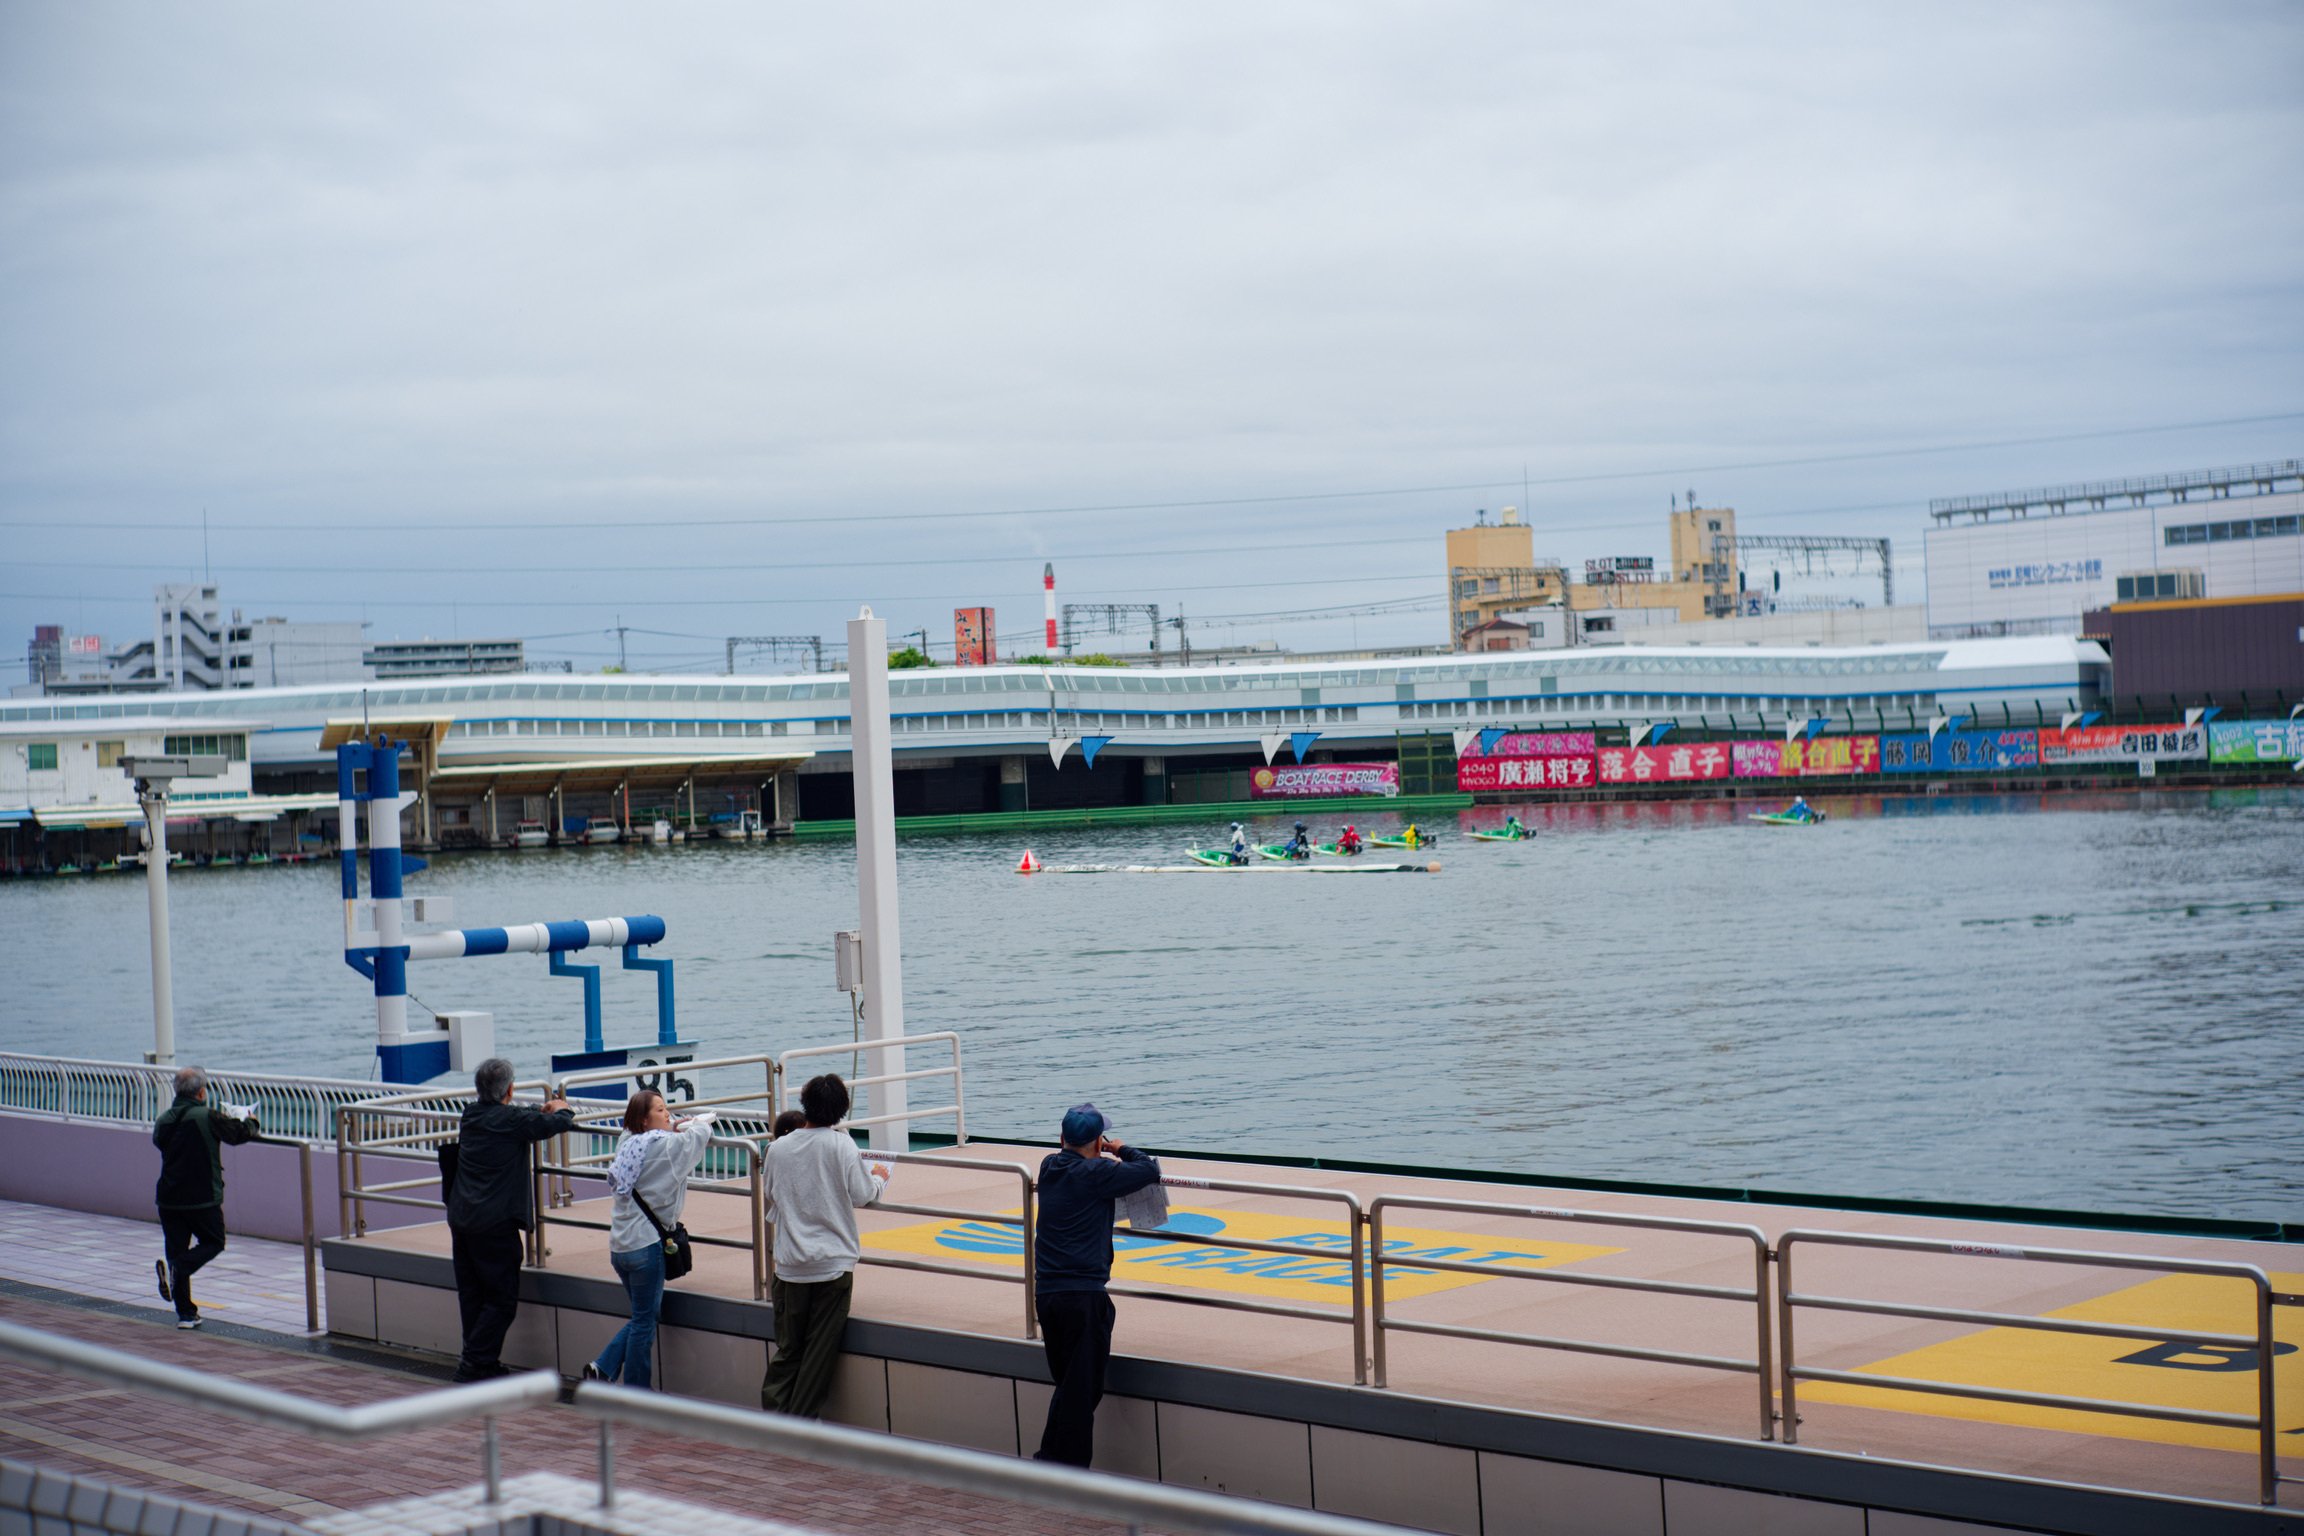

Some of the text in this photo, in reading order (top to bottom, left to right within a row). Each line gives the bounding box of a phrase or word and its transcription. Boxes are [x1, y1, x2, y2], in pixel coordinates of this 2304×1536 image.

[1462, 763, 1495, 776] 4040
[1601, 746, 1725, 779] 落合 直子
[1275, 773, 1311, 786] BOAT
[1310, 771, 1343, 785] RACE
[1345, 769, 1383, 784] DERBY
